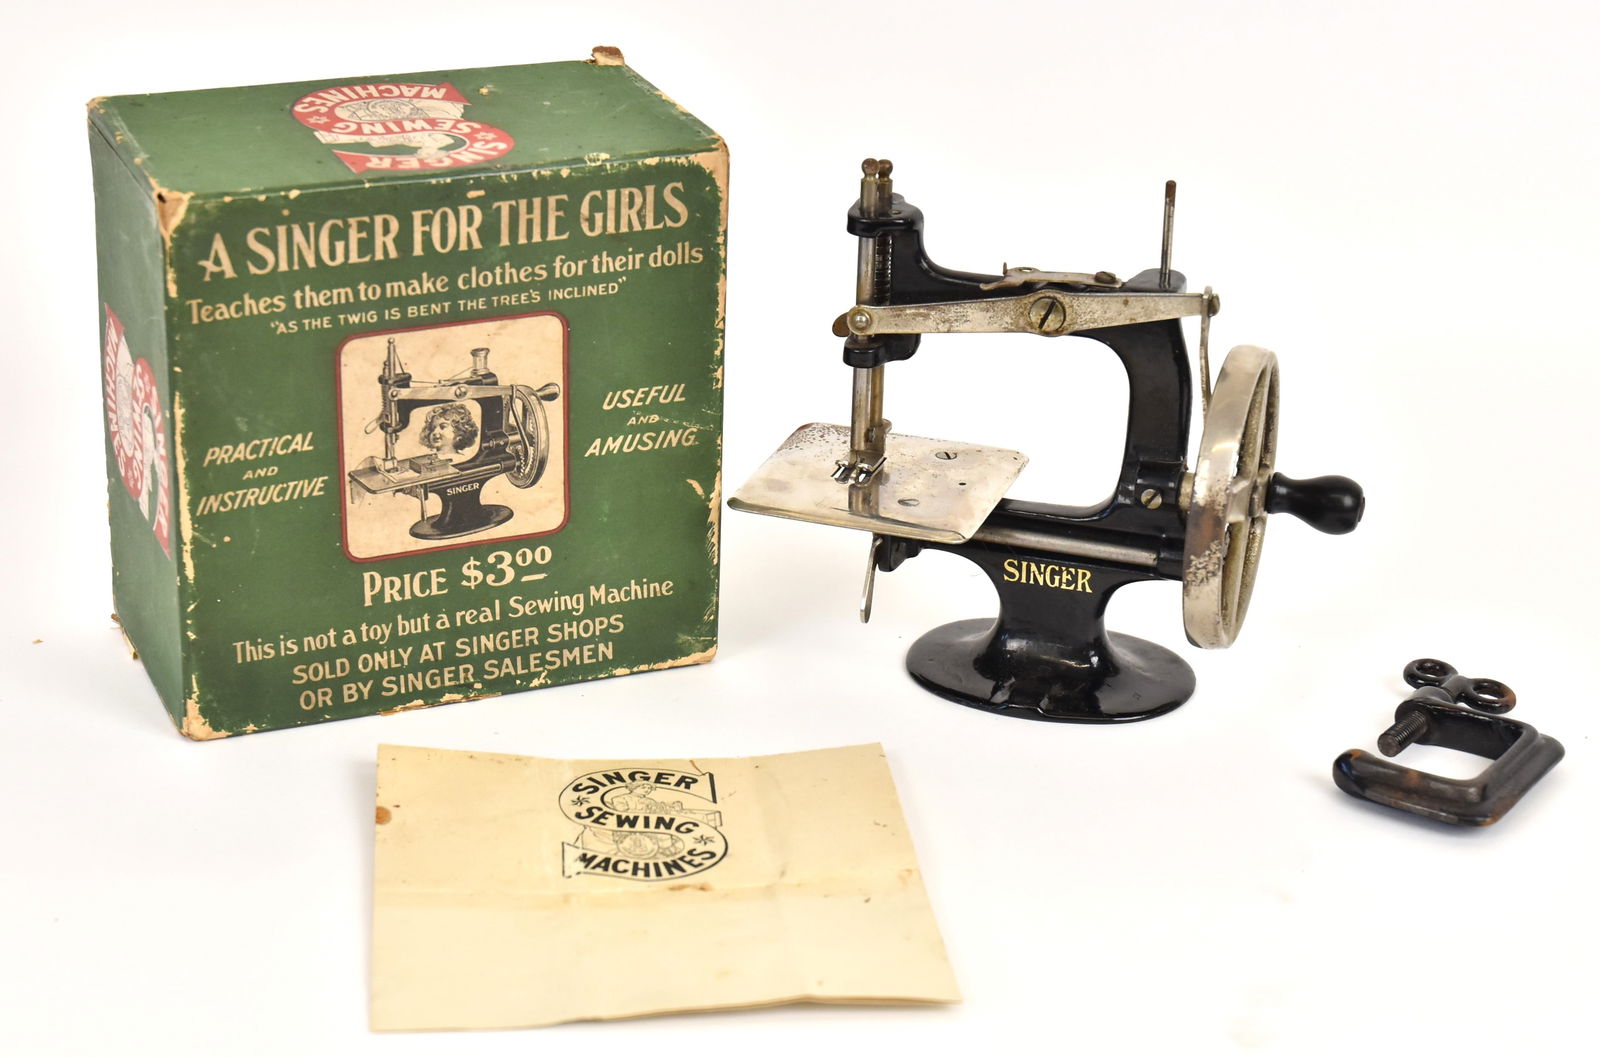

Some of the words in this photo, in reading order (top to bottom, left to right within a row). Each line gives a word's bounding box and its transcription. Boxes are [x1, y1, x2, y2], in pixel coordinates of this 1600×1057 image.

[294, 84, 448, 115] MACHINES
[331, 119, 482, 135] SEWING
[366, 140, 508, 169] SINGER
[197, 232, 238, 281] A
[246, 213, 400, 275] SINGER
[411, 204, 483, 257] FOR
[492, 194, 570, 247] THE
[580, 181, 689, 237] GIRLS
[186, 292, 287, 325] Teaches
[293, 284, 354, 310] them
[358, 281, 381, 300] to
[386, 271, 449, 298] make
[457, 261, 548, 290] clothes
[553, 254, 587, 279] for
[591, 247, 644, 274] their
[648, 240, 704, 268] dolls
[302, 317, 332, 330] THE
[338, 310, 378, 326] TWIG
[384, 307, 401, 320] IS
[407, 301, 452, 318] BENT
[457, 297, 487, 311] THE
[105, 317, 125, 478] MACHINES
[602, 383, 686, 411] USEFUL
[132, 363, 146, 490] SEWING
[626, 414, 660, 426] AND
[203, 431, 314, 468] PRACTICAL
[584, 427, 698, 458] AMUSING
[242, 466, 279, 480] AND
[446, 482, 480, 496] SINGER
[196, 476, 329, 517] INSTRUCTIVE
[362, 567, 449, 607] PRICE
[1003, 558, 1093, 593] SINGER
[232, 637, 276, 664] This
[280, 634, 299, 657] is
[303, 628, 337, 652] not
[342, 629, 357, 646] a
[360, 622, 392, 645] toy
[396, 612, 430, 636] but
[435, 612, 450, 630] a
[455, 599, 500, 627] real
[508, 590, 584, 618] Sewing
[589, 578, 674, 607] Machine
[292, 657, 350, 685] SOLD
[357, 646, 413, 673] ONLY
[419, 641, 446, 664] AT
[455, 626, 539, 658] SINGER
[547, 614, 625, 643] SHOPS
[299, 687, 333, 711] OR
[342, 679, 374, 704] BY
[381, 663, 474, 697] SINGER
[483, 641, 614, 680] SALESMEN
[572, 770, 699, 795] SINGER
[574, 806, 700, 834] SEWING
[577, 848, 717, 878] MACHINES
